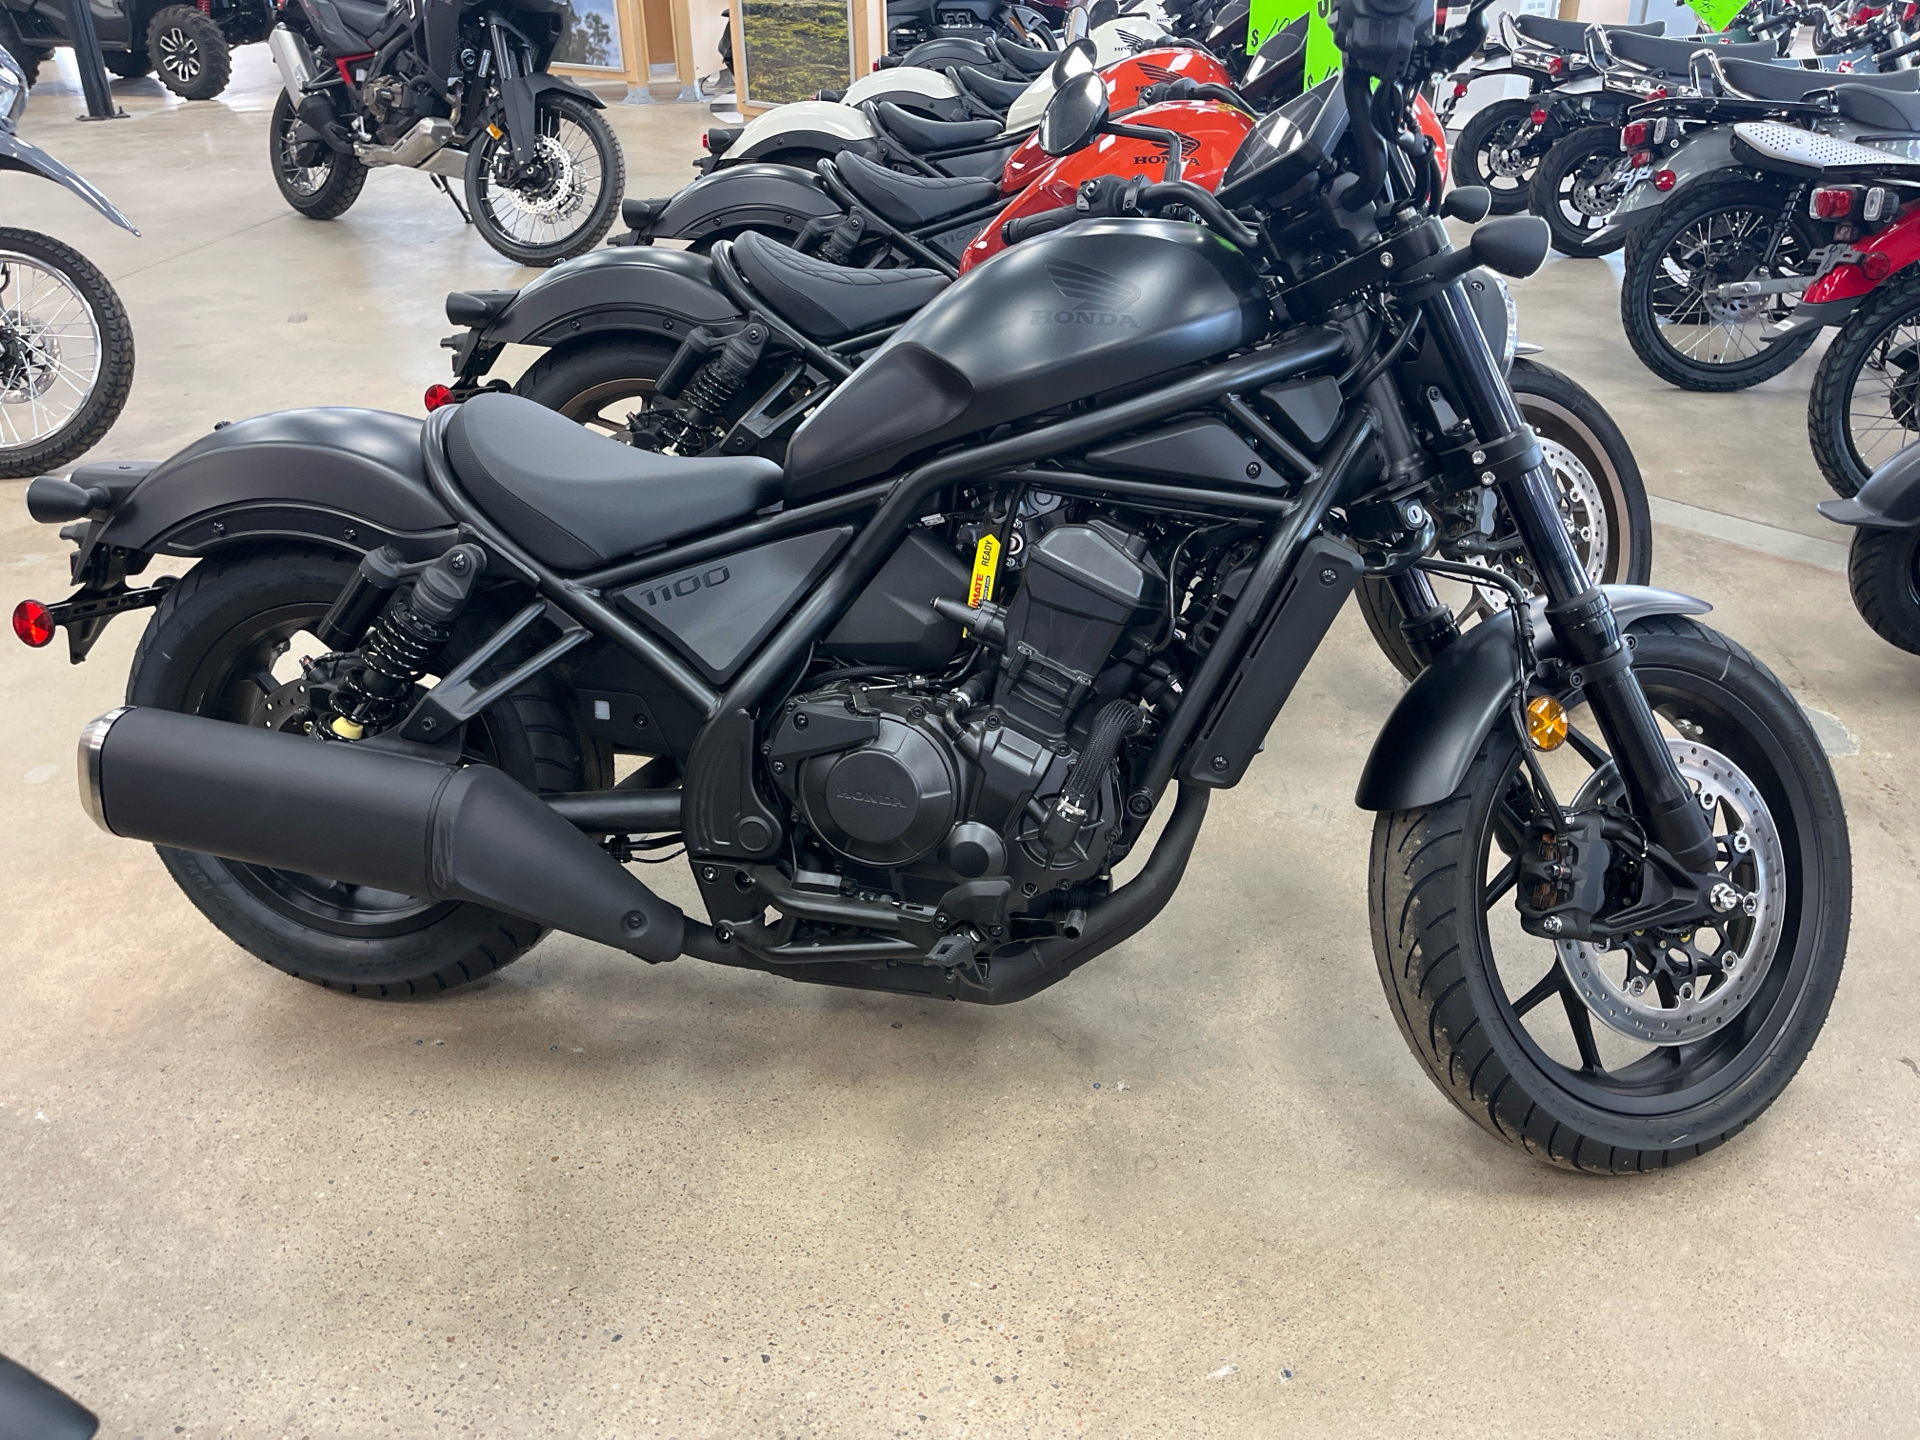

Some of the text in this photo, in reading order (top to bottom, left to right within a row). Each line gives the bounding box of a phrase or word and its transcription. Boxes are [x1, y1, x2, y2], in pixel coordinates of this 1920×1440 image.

[1029, 309, 1141, 330] HONDA
[981, 540, 993, 567] READY
[639, 565, 731, 607] 1100
[836, 788, 908, 809] HONDA
